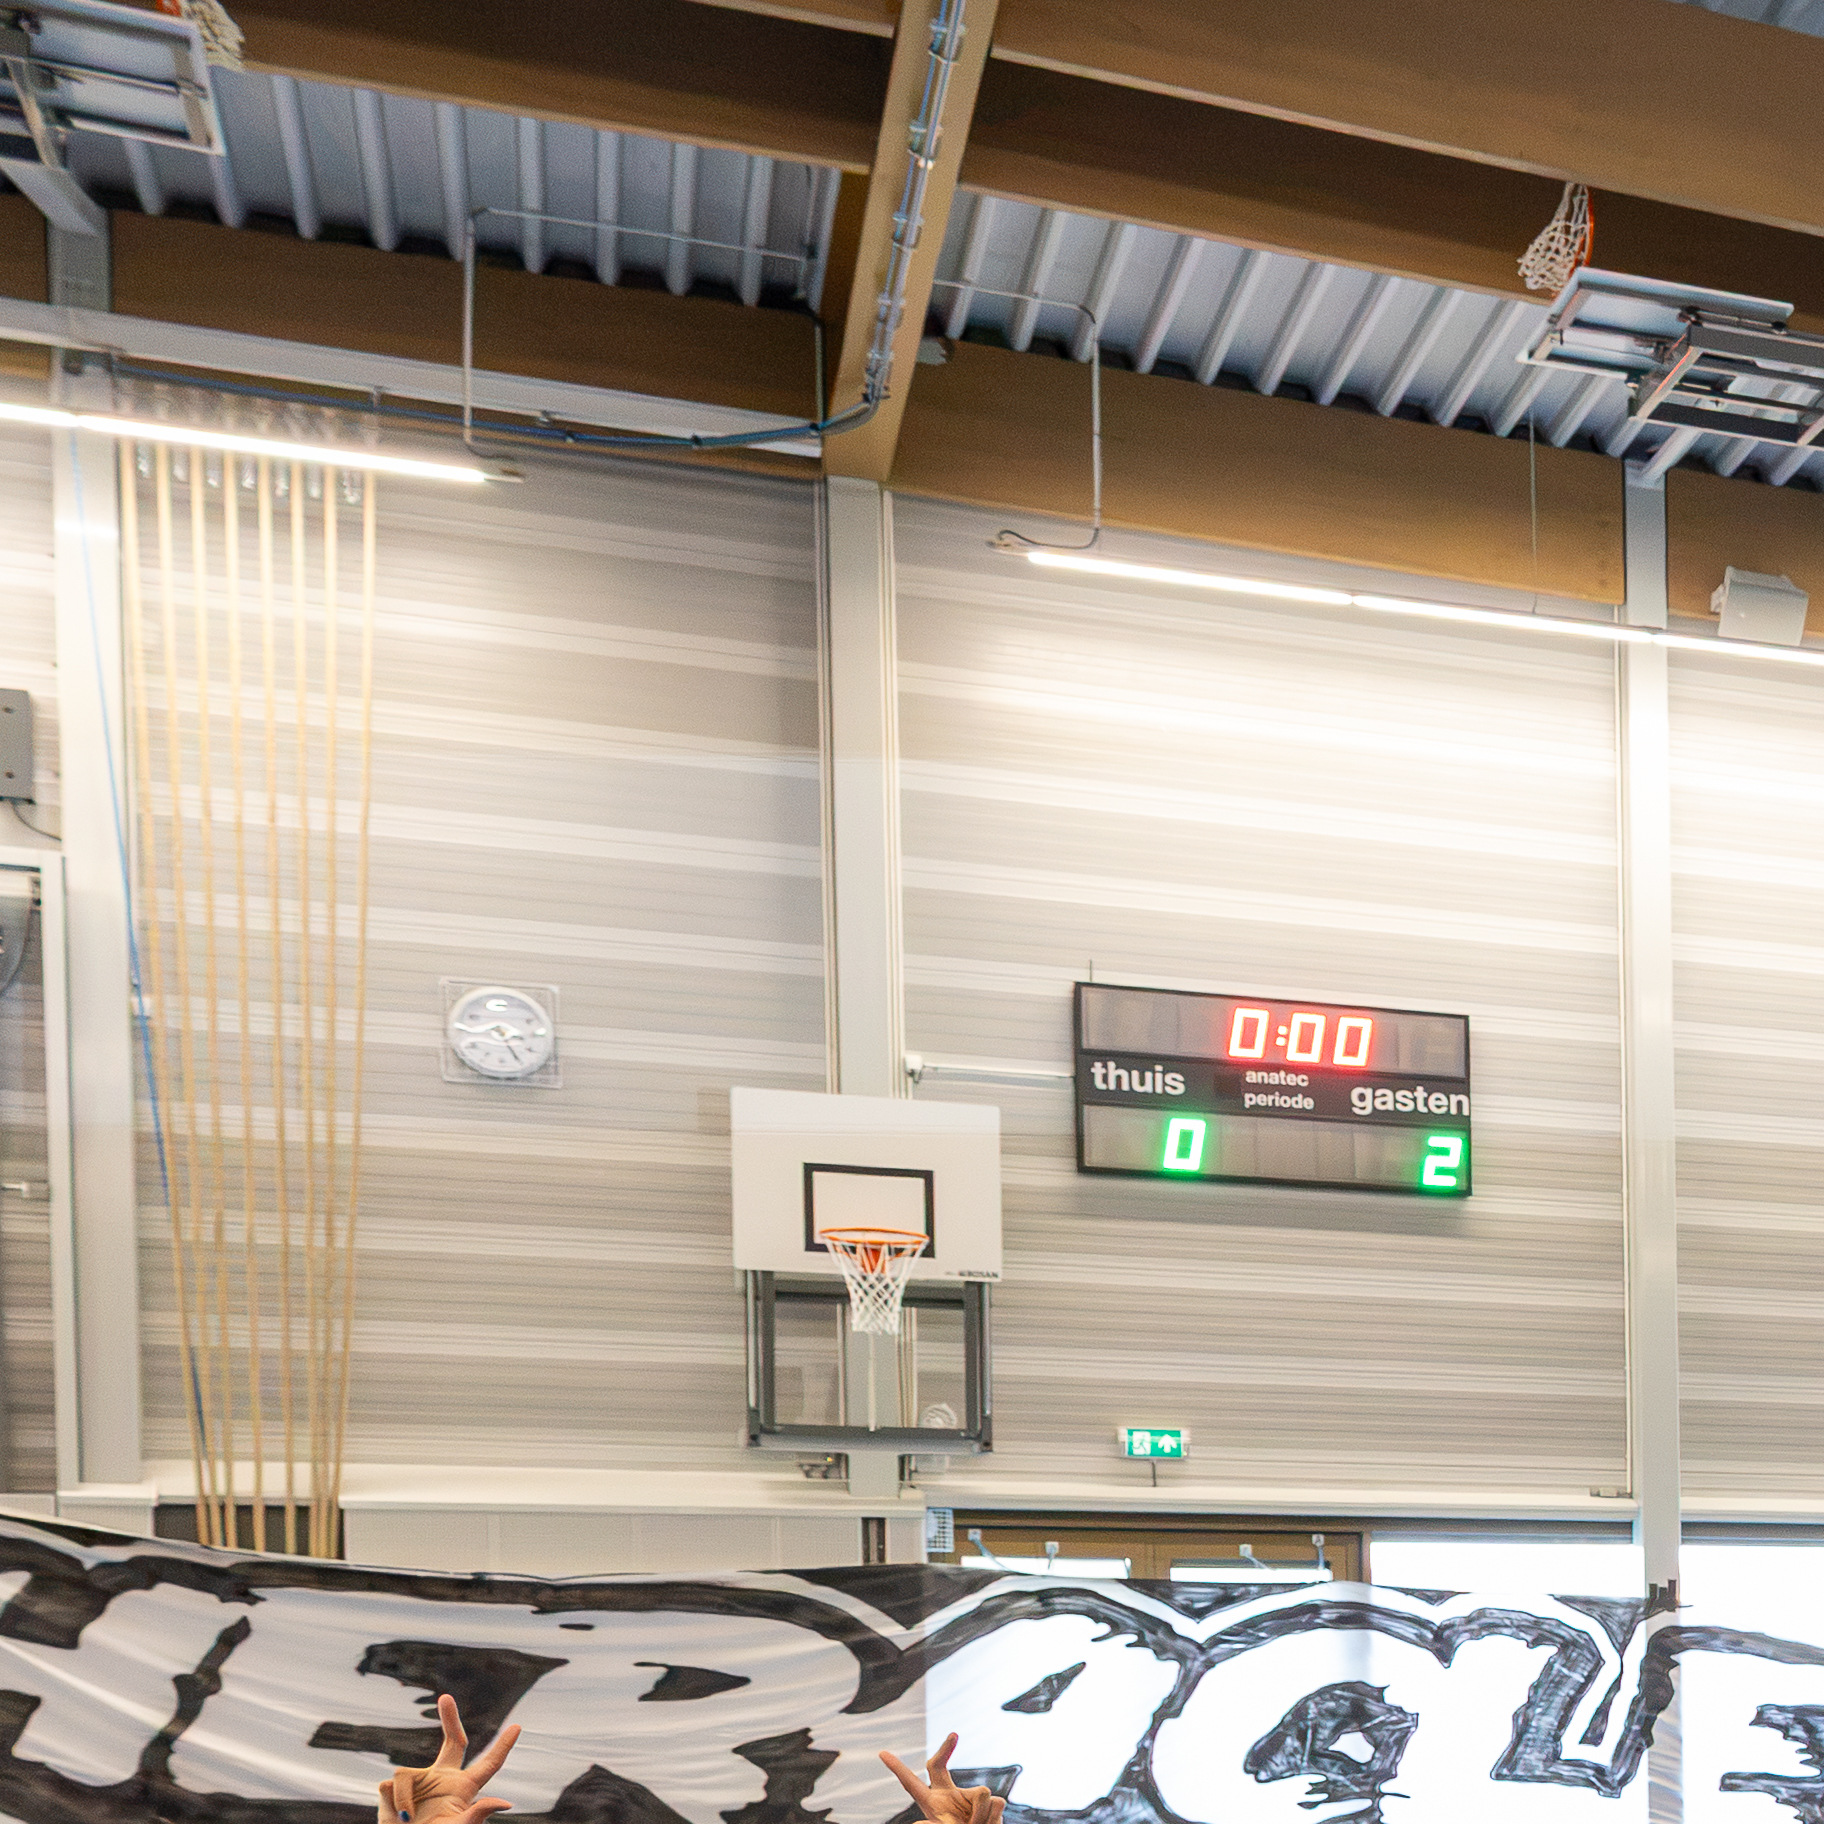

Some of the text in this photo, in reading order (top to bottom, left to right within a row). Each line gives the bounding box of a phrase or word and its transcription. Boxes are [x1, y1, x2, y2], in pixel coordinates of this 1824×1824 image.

[1228, 1007, 1373, 1067] 0:00
[1091, 1060, 1470, 1116] thuis gasten
[1243, 1090, 1315, 1111] periode
[1245, 1068, 1309, 1088] anatec
[1163, 1117, 1207, 1171] 0
[1422, 1135, 1463, 1187] 2
